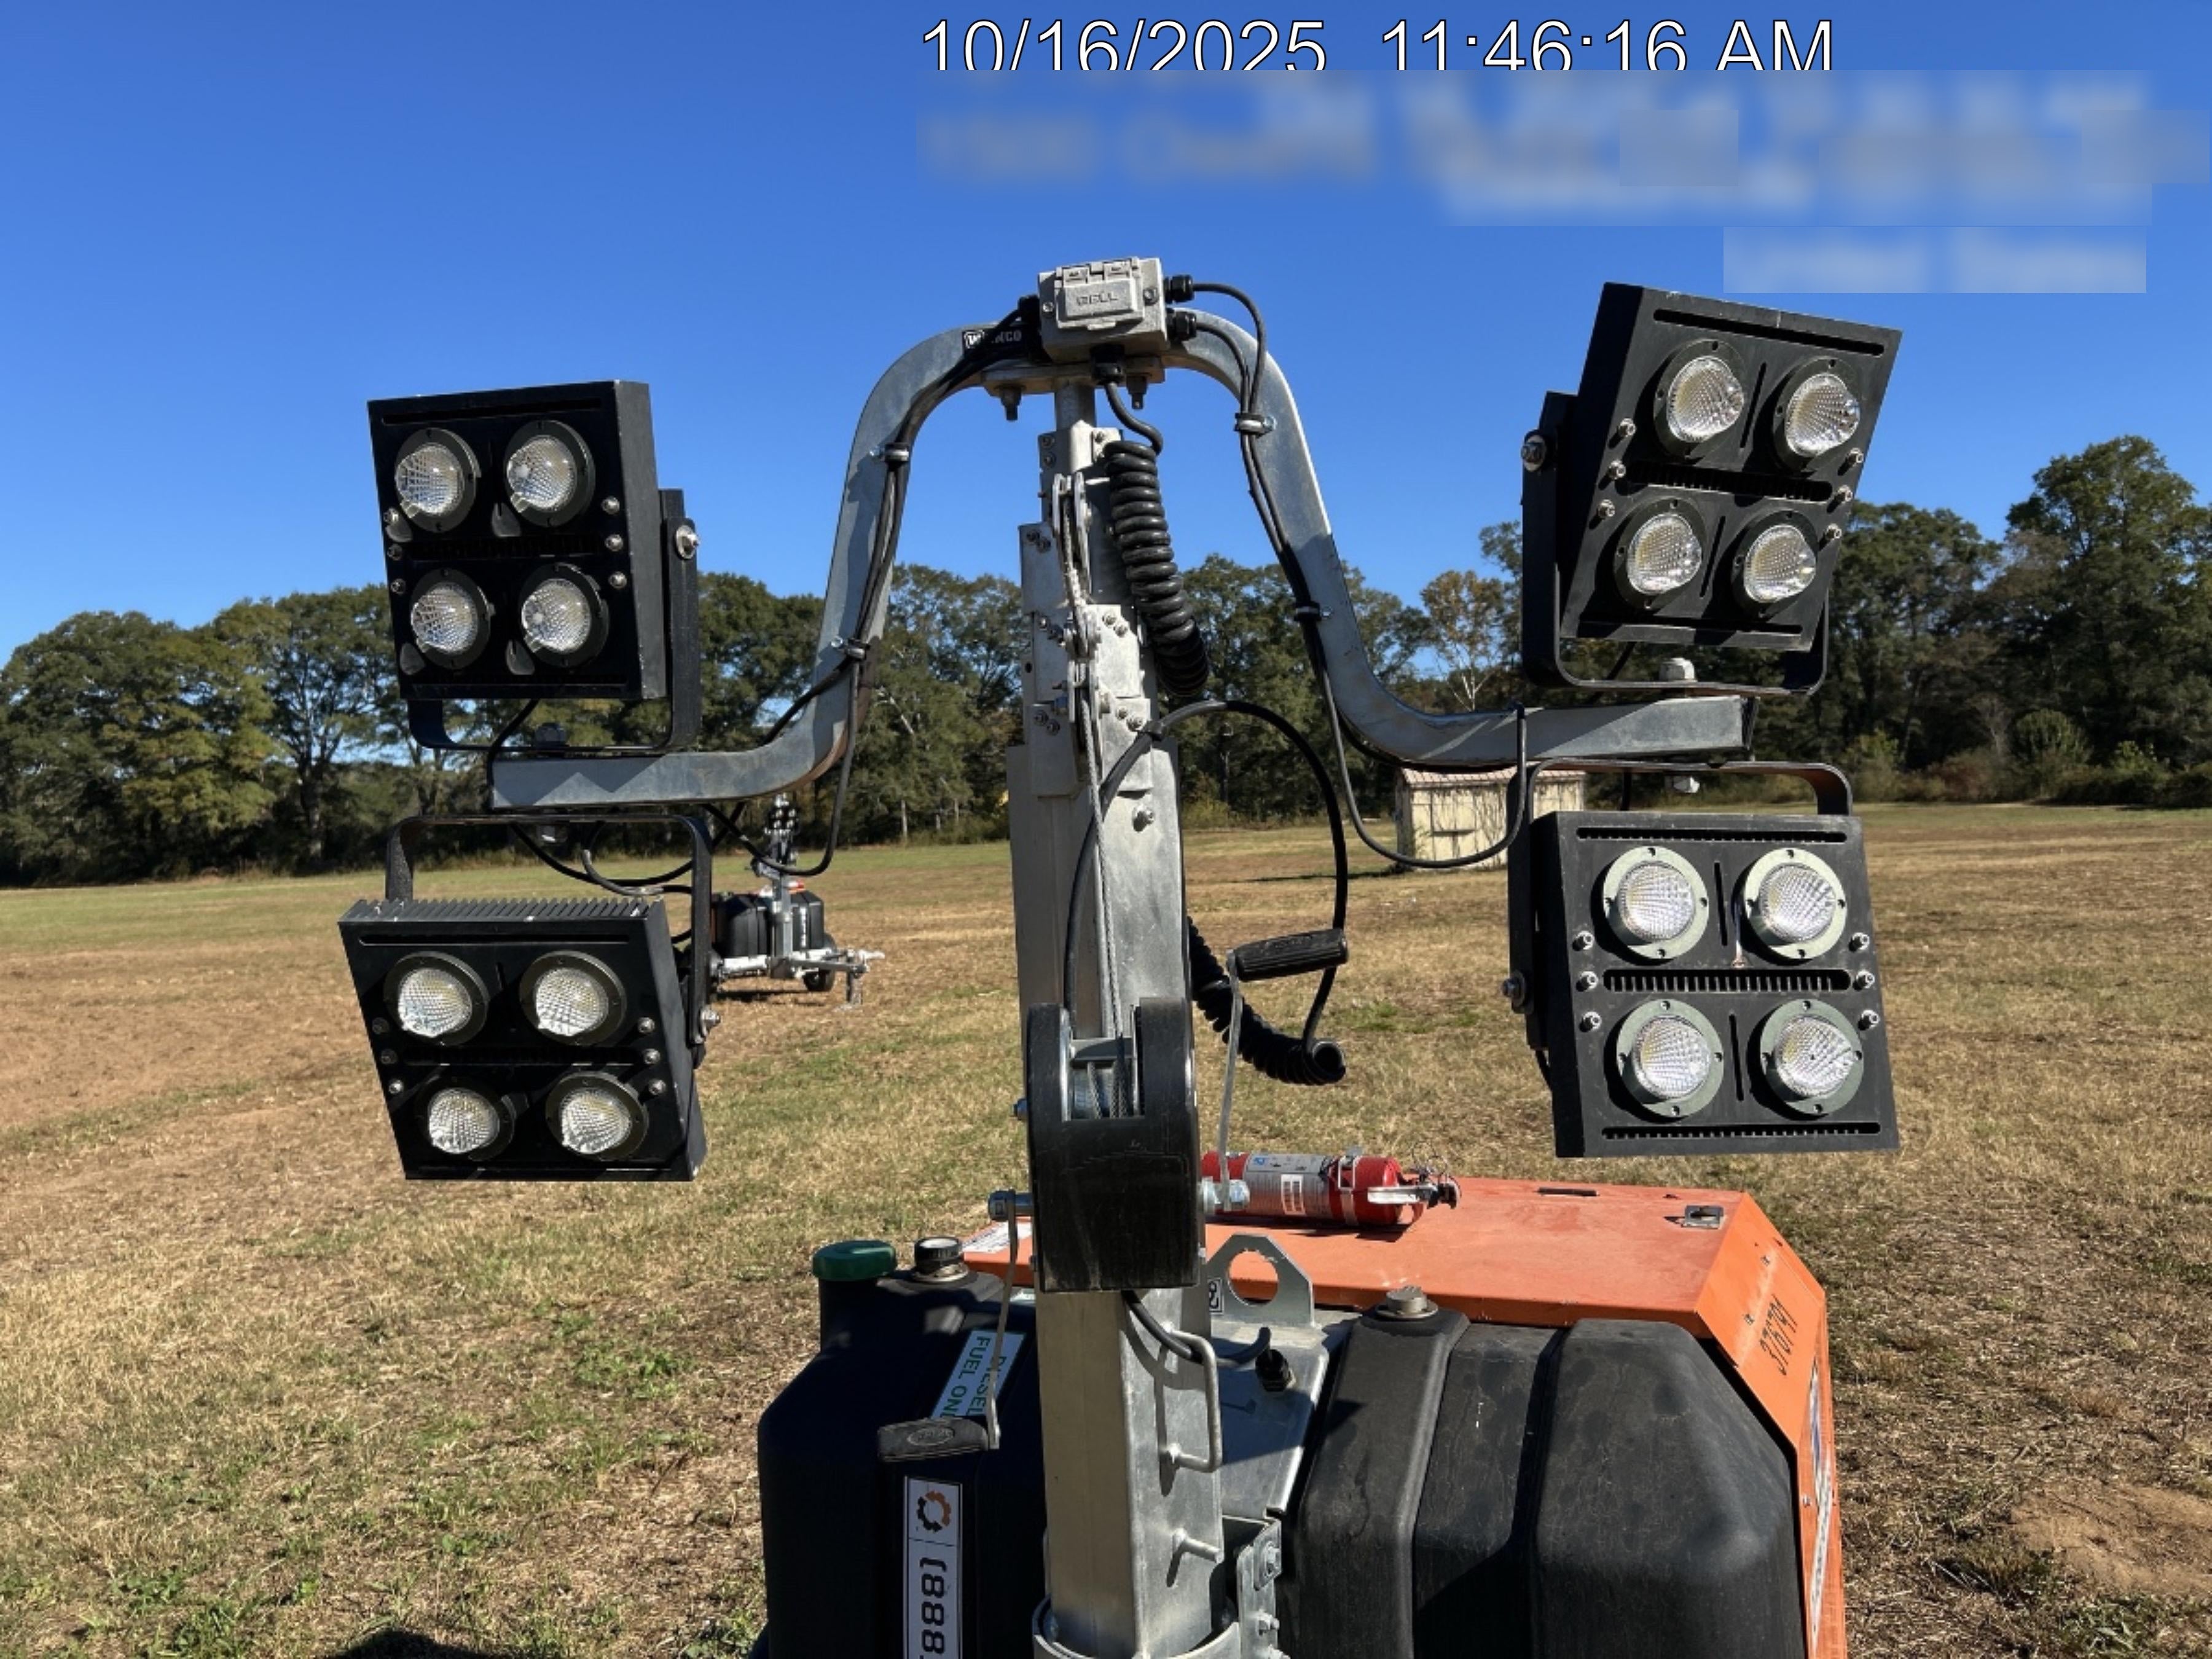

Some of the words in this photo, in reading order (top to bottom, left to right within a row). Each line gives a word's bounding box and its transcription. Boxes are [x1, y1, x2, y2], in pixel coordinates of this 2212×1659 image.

[958, 1336, 991, 1379] FUEL
[940, 1385, 967, 1418] ONL
[919, 1557, 947, 1659] (888
